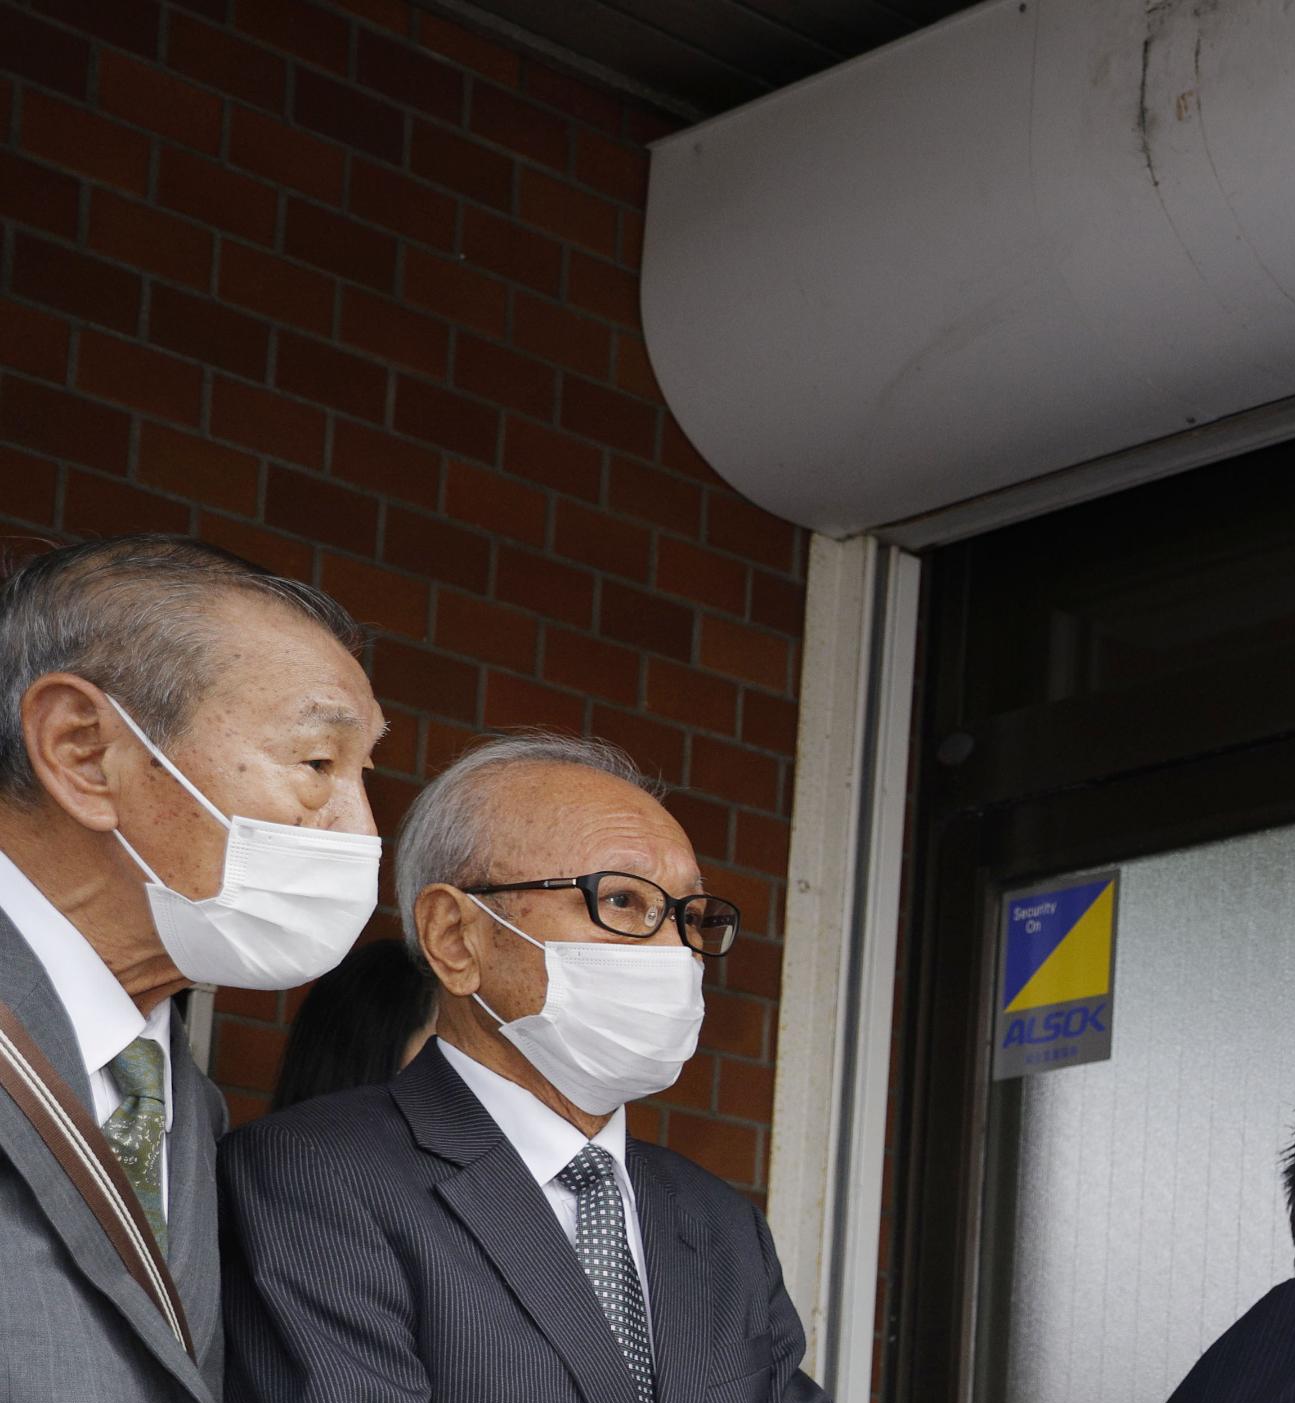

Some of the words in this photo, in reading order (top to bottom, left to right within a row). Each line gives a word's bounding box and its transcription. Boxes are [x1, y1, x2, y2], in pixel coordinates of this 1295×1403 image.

[1013, 902, 1057, 921] Security
[1026, 919, 1042, 934] On
[1003, 1003, 1107, 1049] ALSOK
